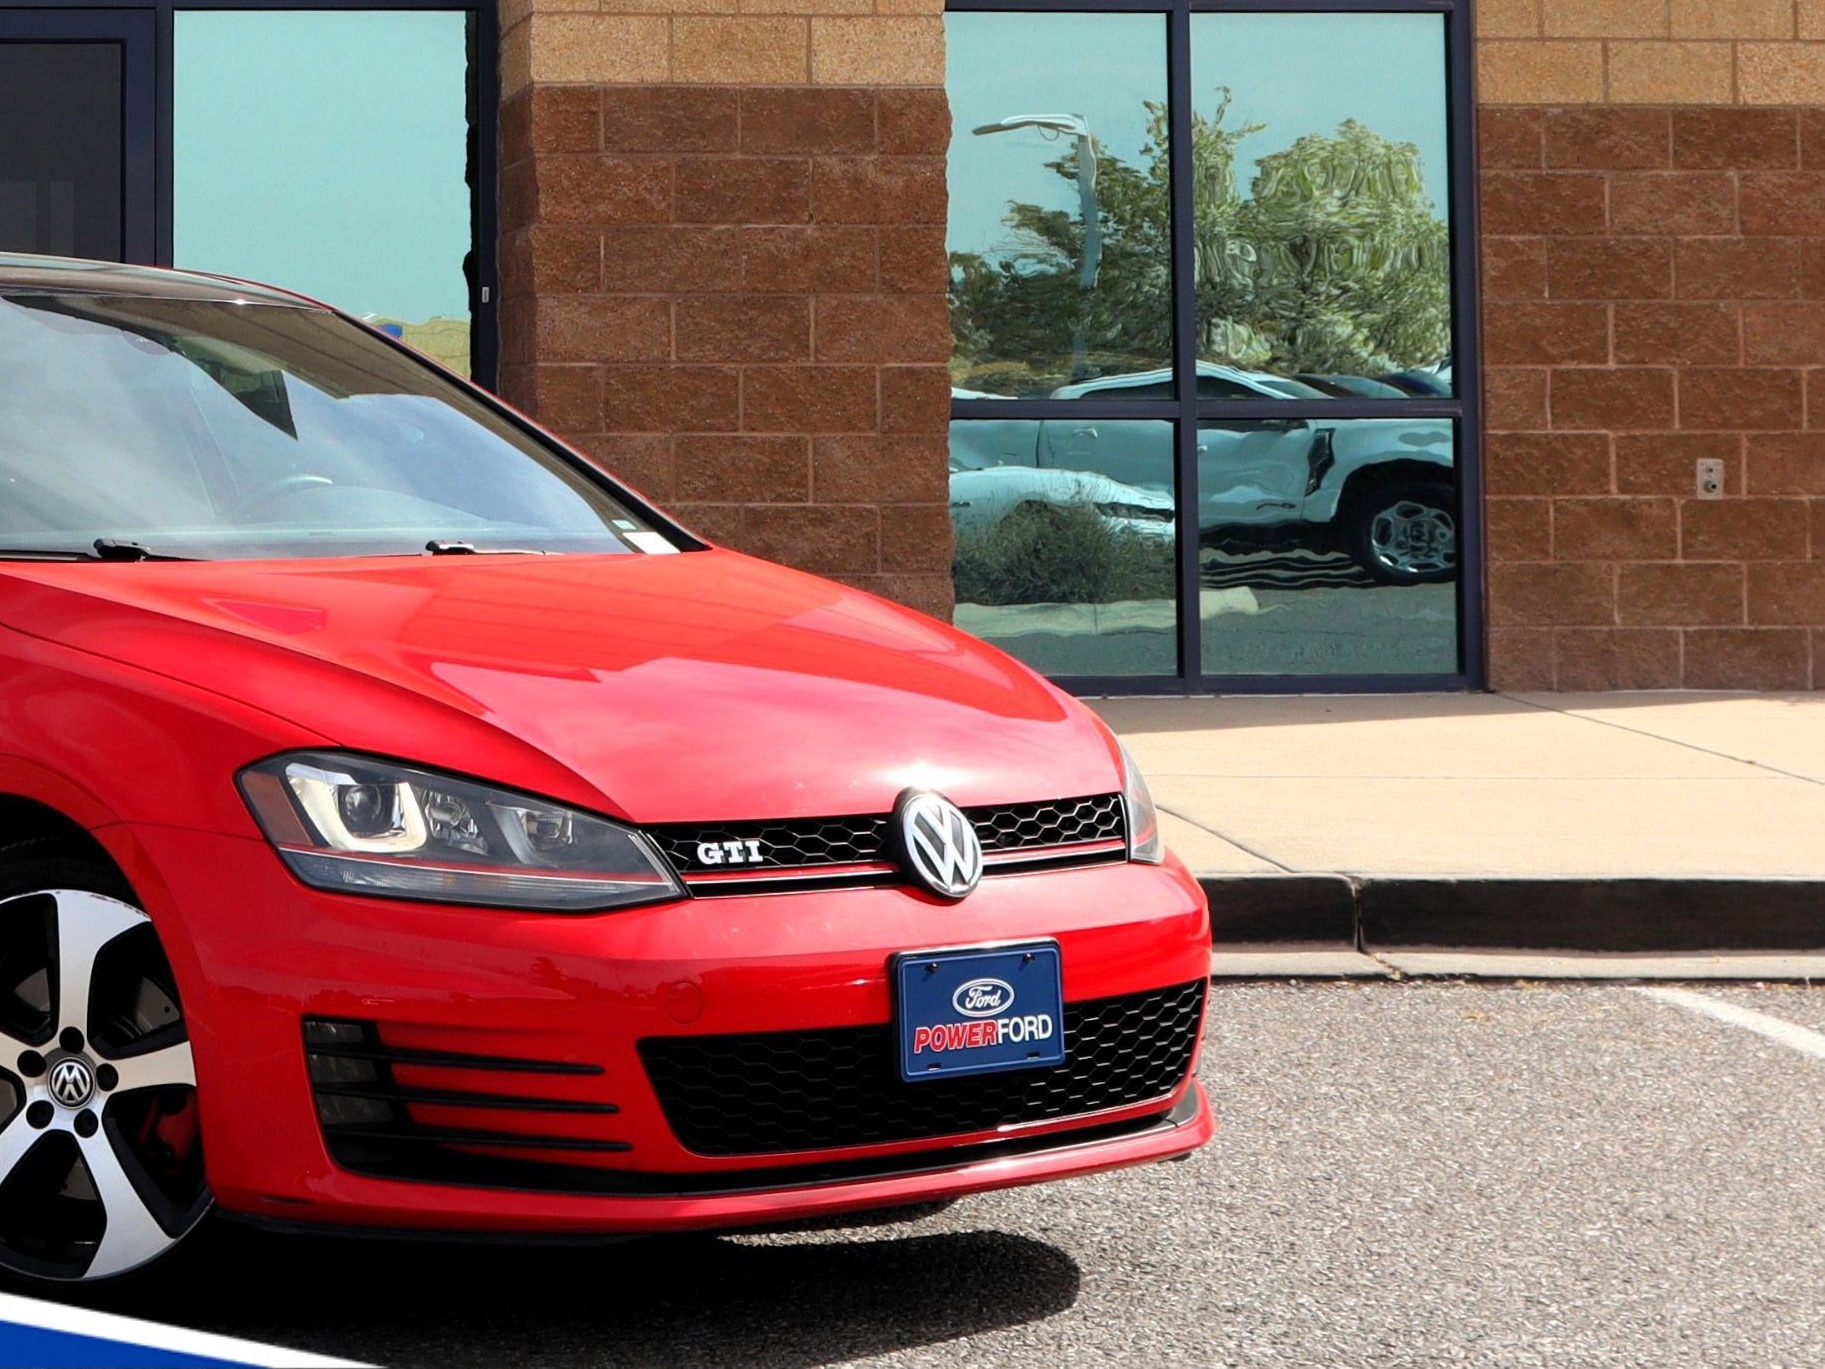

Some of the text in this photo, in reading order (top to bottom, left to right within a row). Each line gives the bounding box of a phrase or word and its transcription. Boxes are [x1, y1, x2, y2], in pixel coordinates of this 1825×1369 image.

[696, 840, 764, 865] GTI
[965, 985, 1002, 1010] Ford
[913, 1014, 1053, 1054] POWERFORD
